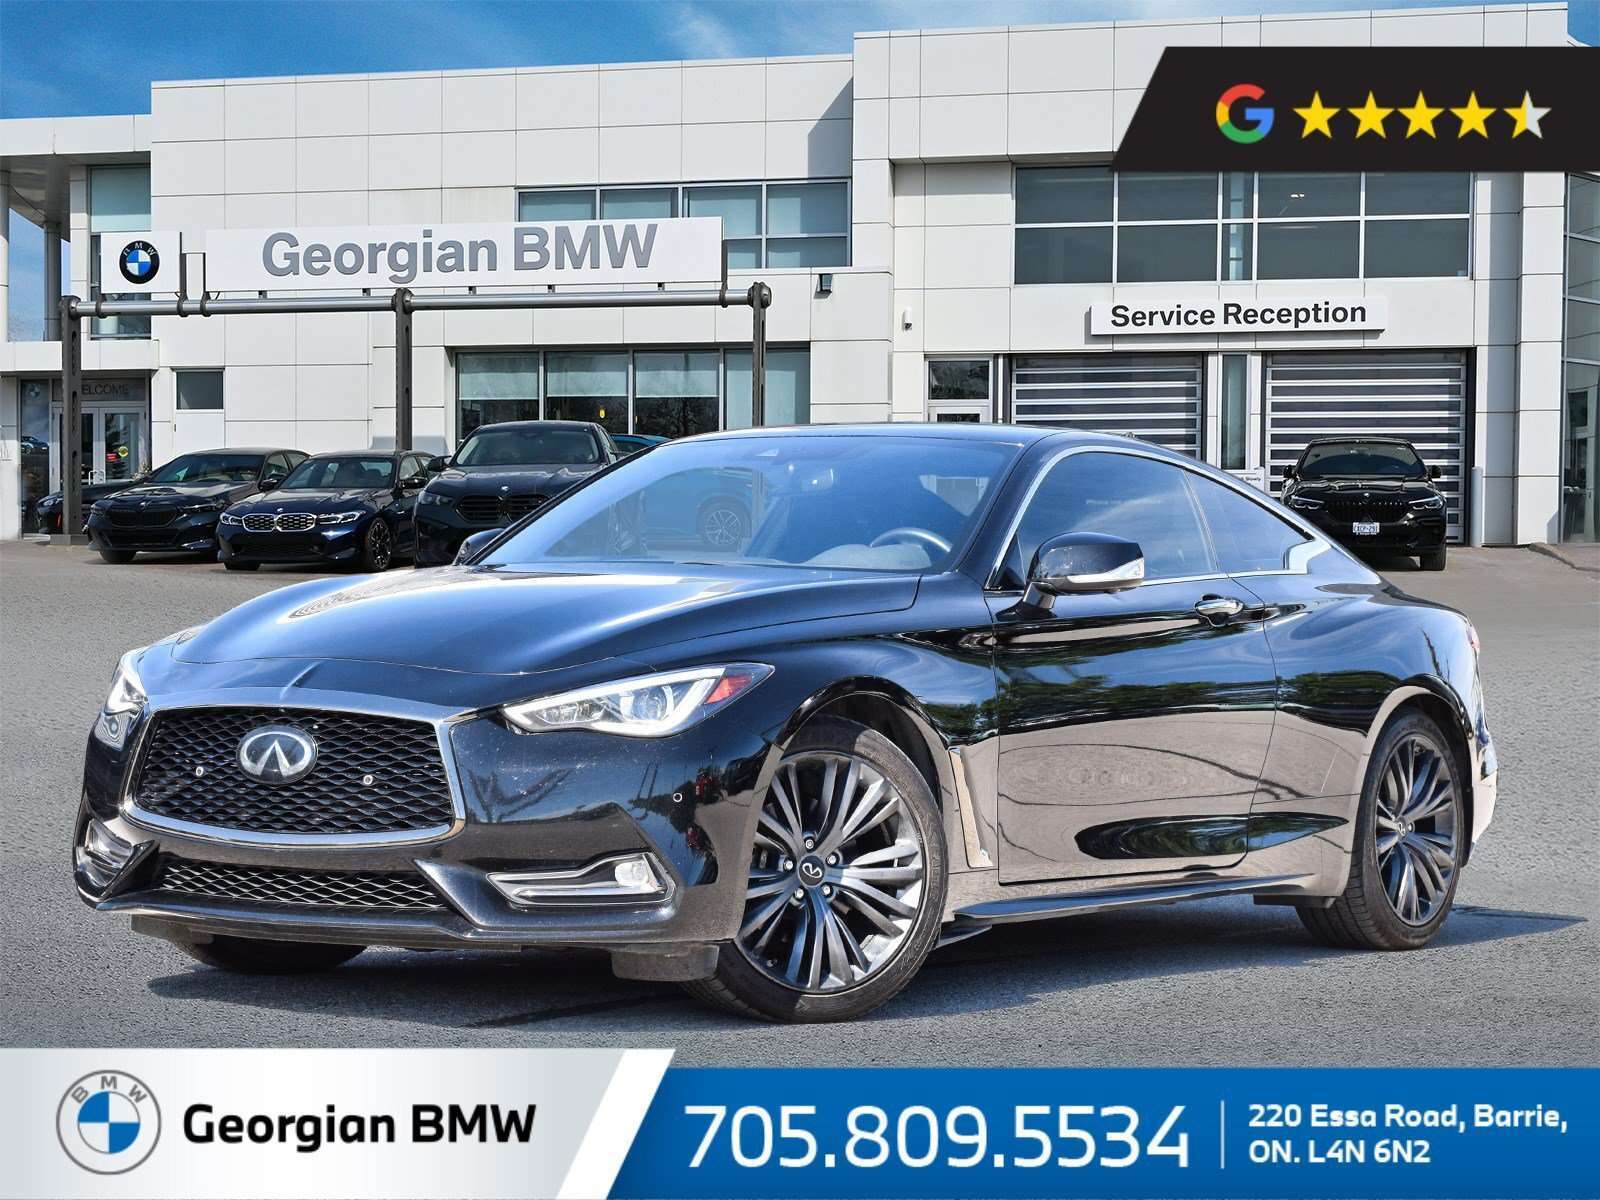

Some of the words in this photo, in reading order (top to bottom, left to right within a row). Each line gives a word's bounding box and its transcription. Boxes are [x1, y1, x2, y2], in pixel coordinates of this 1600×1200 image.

[122, 242, 159, 256] BMW
[262, 229, 499, 284] Georgian
[512, 224, 658, 270] BMW
[1111, 304, 1216, 328] Service
[1223, 302, 1367, 329] Reception
[81, 384, 130, 396] ELCOME
